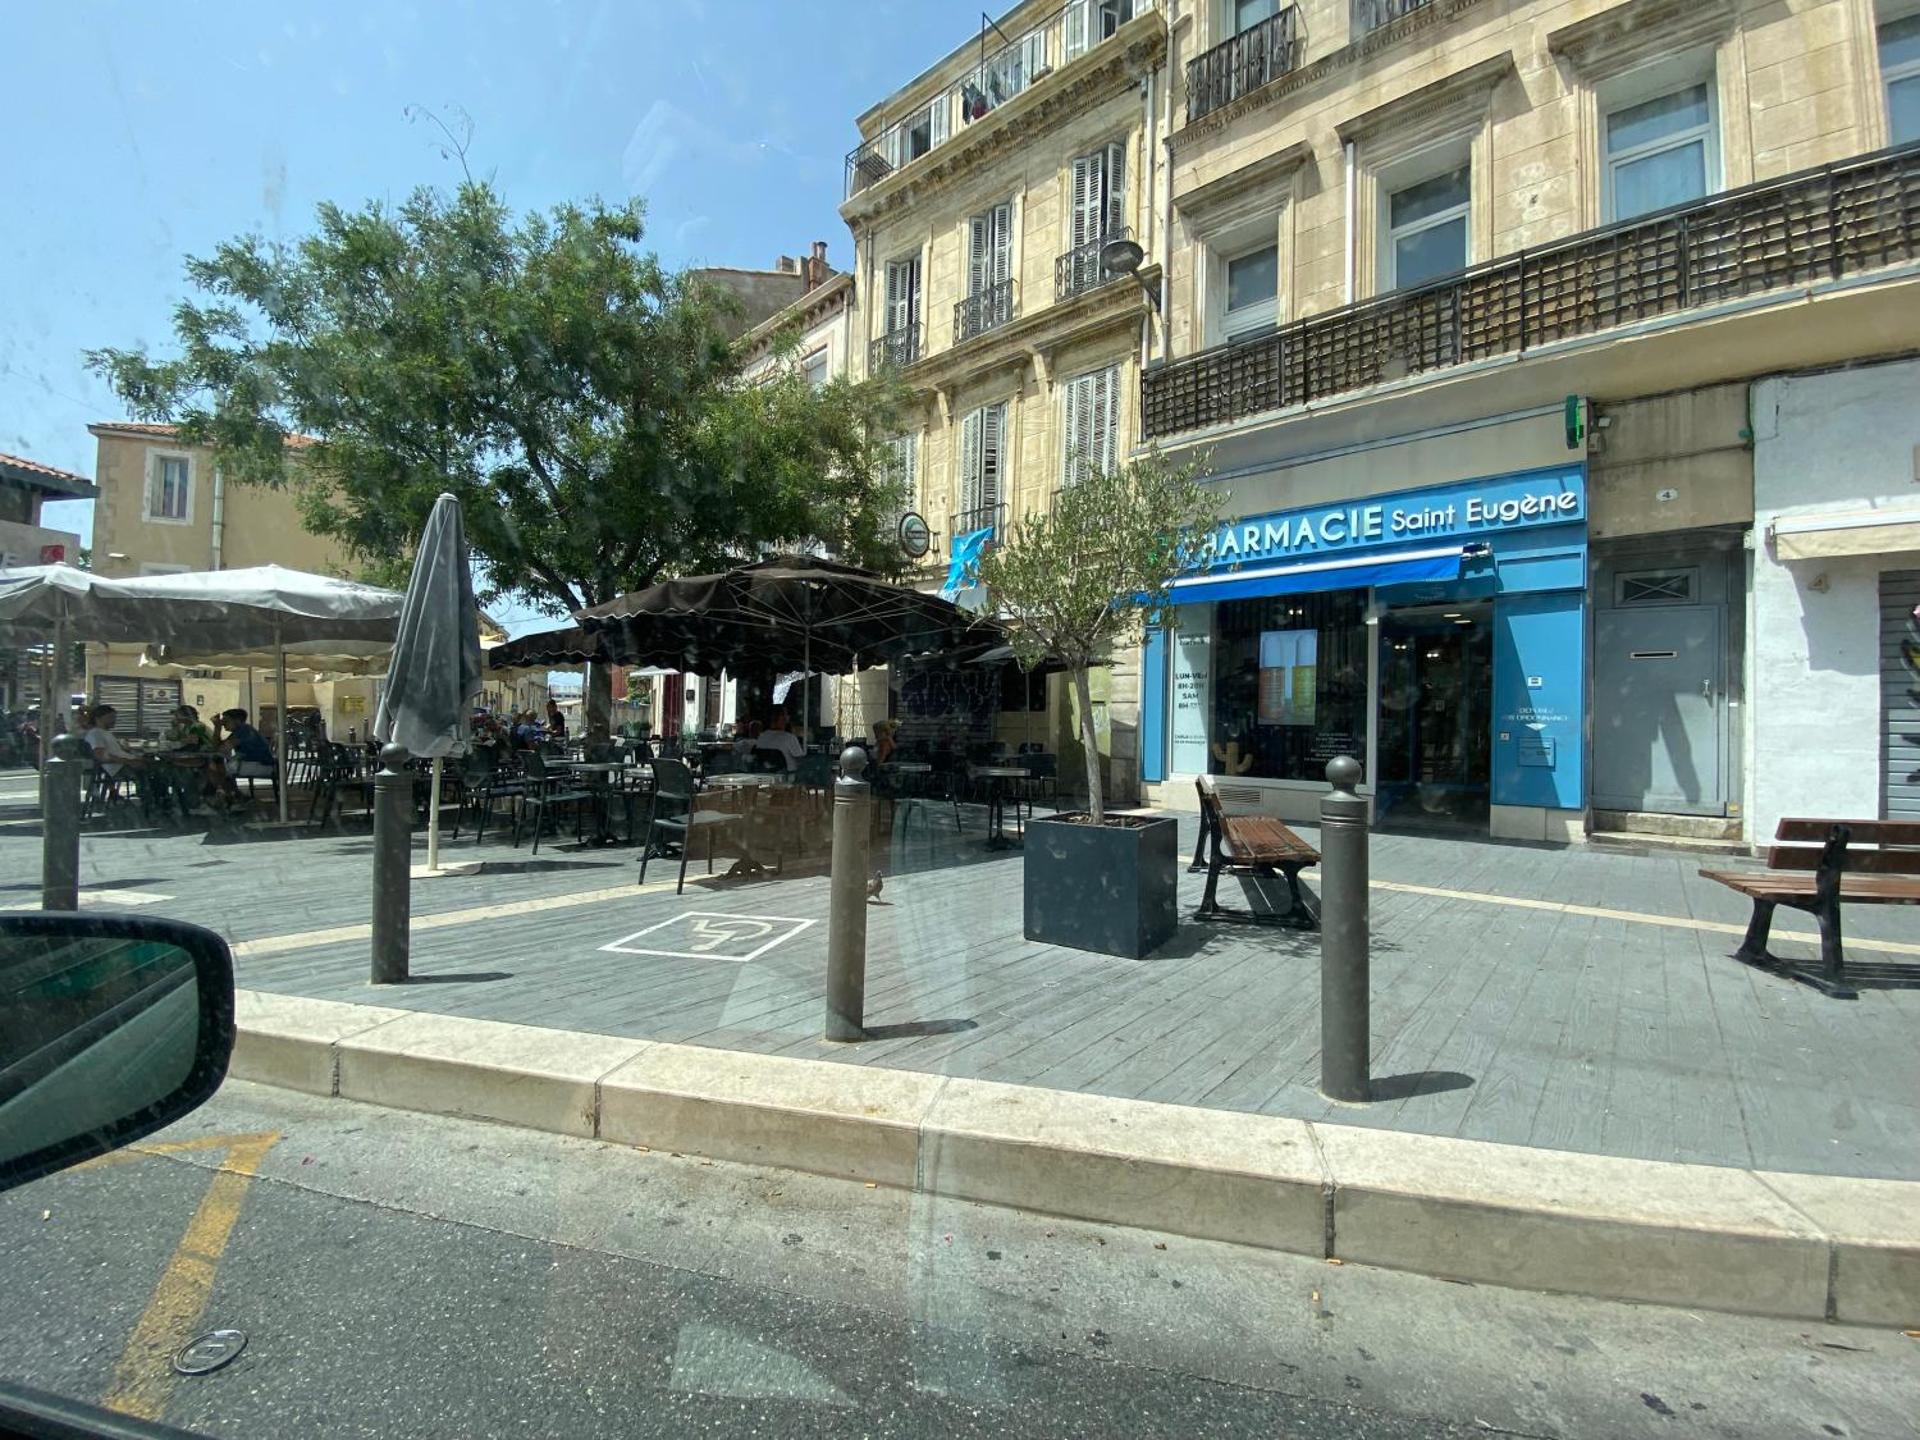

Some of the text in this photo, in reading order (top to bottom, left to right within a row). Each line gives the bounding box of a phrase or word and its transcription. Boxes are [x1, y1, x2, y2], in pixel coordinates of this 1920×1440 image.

[1184, 491, 1577, 560] HARMACIE Saint Eugène
